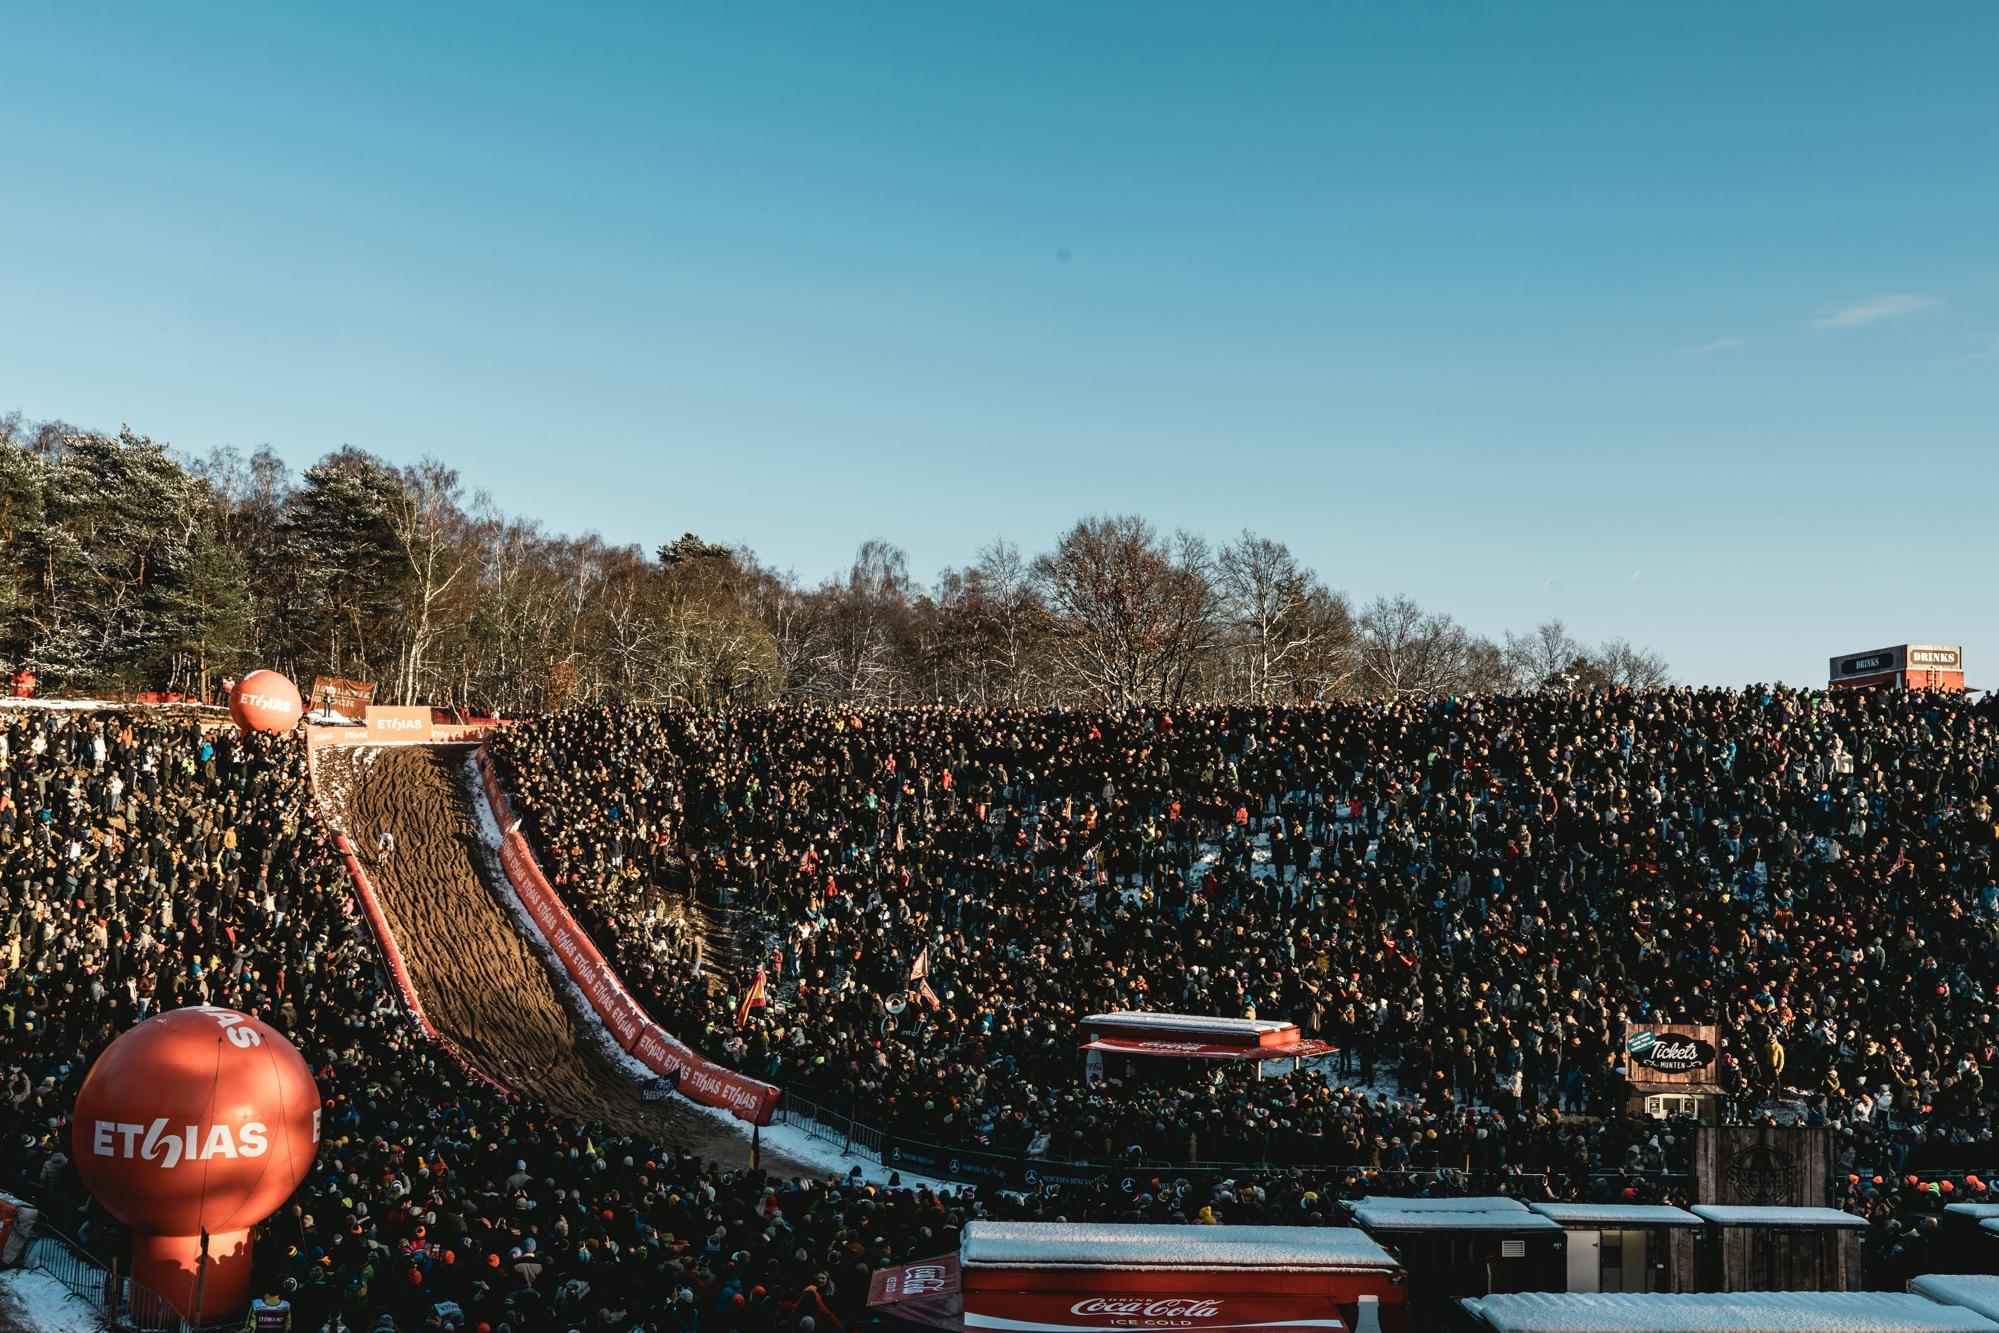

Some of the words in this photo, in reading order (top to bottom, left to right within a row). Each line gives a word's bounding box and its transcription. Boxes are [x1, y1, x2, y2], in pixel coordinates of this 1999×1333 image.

[1855, 657, 1880, 669] DRINKS
[1913, 651, 1955, 663] DRINKS
[1651, 1041, 1699, 1060] Tickets
[1660, 1061, 1686, 1069] MUNTEN
[1070, 1298, 1225, 1317] Coca-Cola
